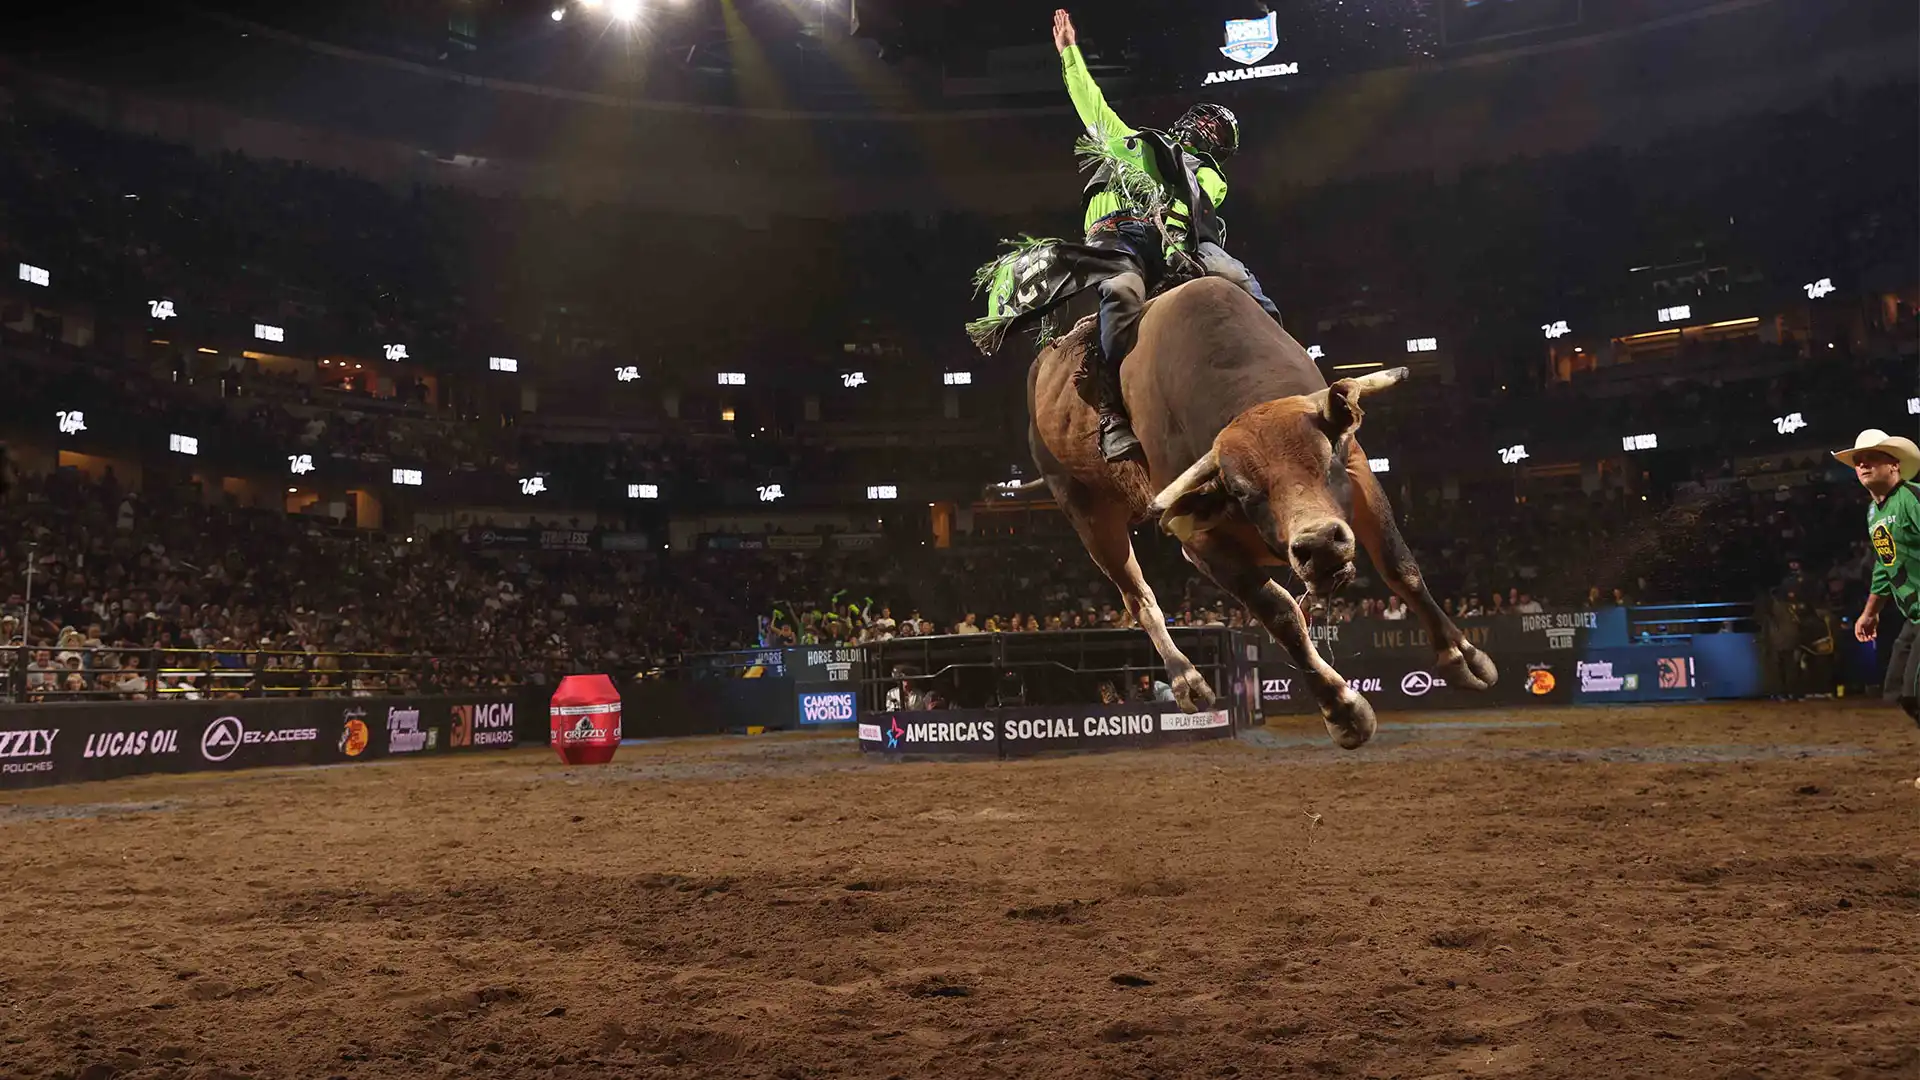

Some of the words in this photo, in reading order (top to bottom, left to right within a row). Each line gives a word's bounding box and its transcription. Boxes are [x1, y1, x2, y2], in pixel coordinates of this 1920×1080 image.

[1204, 62, 1299, 84] ANAHEIM
[1522, 614, 1552, 632] HORSE
[1556, 612, 1597, 629] SOLDIER
[1373, 630, 1403, 648] LIVE
[1550, 636, 1573, 649] CLUB
[808, 650, 833, 666] HORSE
[829, 670, 849, 681] CLUB
[1362, 678, 1382, 692] OIL
[804, 694, 852, 708] CAMPING
[474, 703, 513, 729] MGM
[804, 706, 853, 720] WORLD
[243, 728, 318, 744] EZ-ACCESS
[905, 721, 995, 743] AMERICA'S
[1004, 718, 1080, 740] SOCIAL
[1083, 714, 1154, 738] CASINO
[83, 730, 149, 758] LUCAS
[150, 729, 178, 754] OIL
[474, 731, 513, 745] REWARDS
[2, 761, 53, 773] POUCHES
